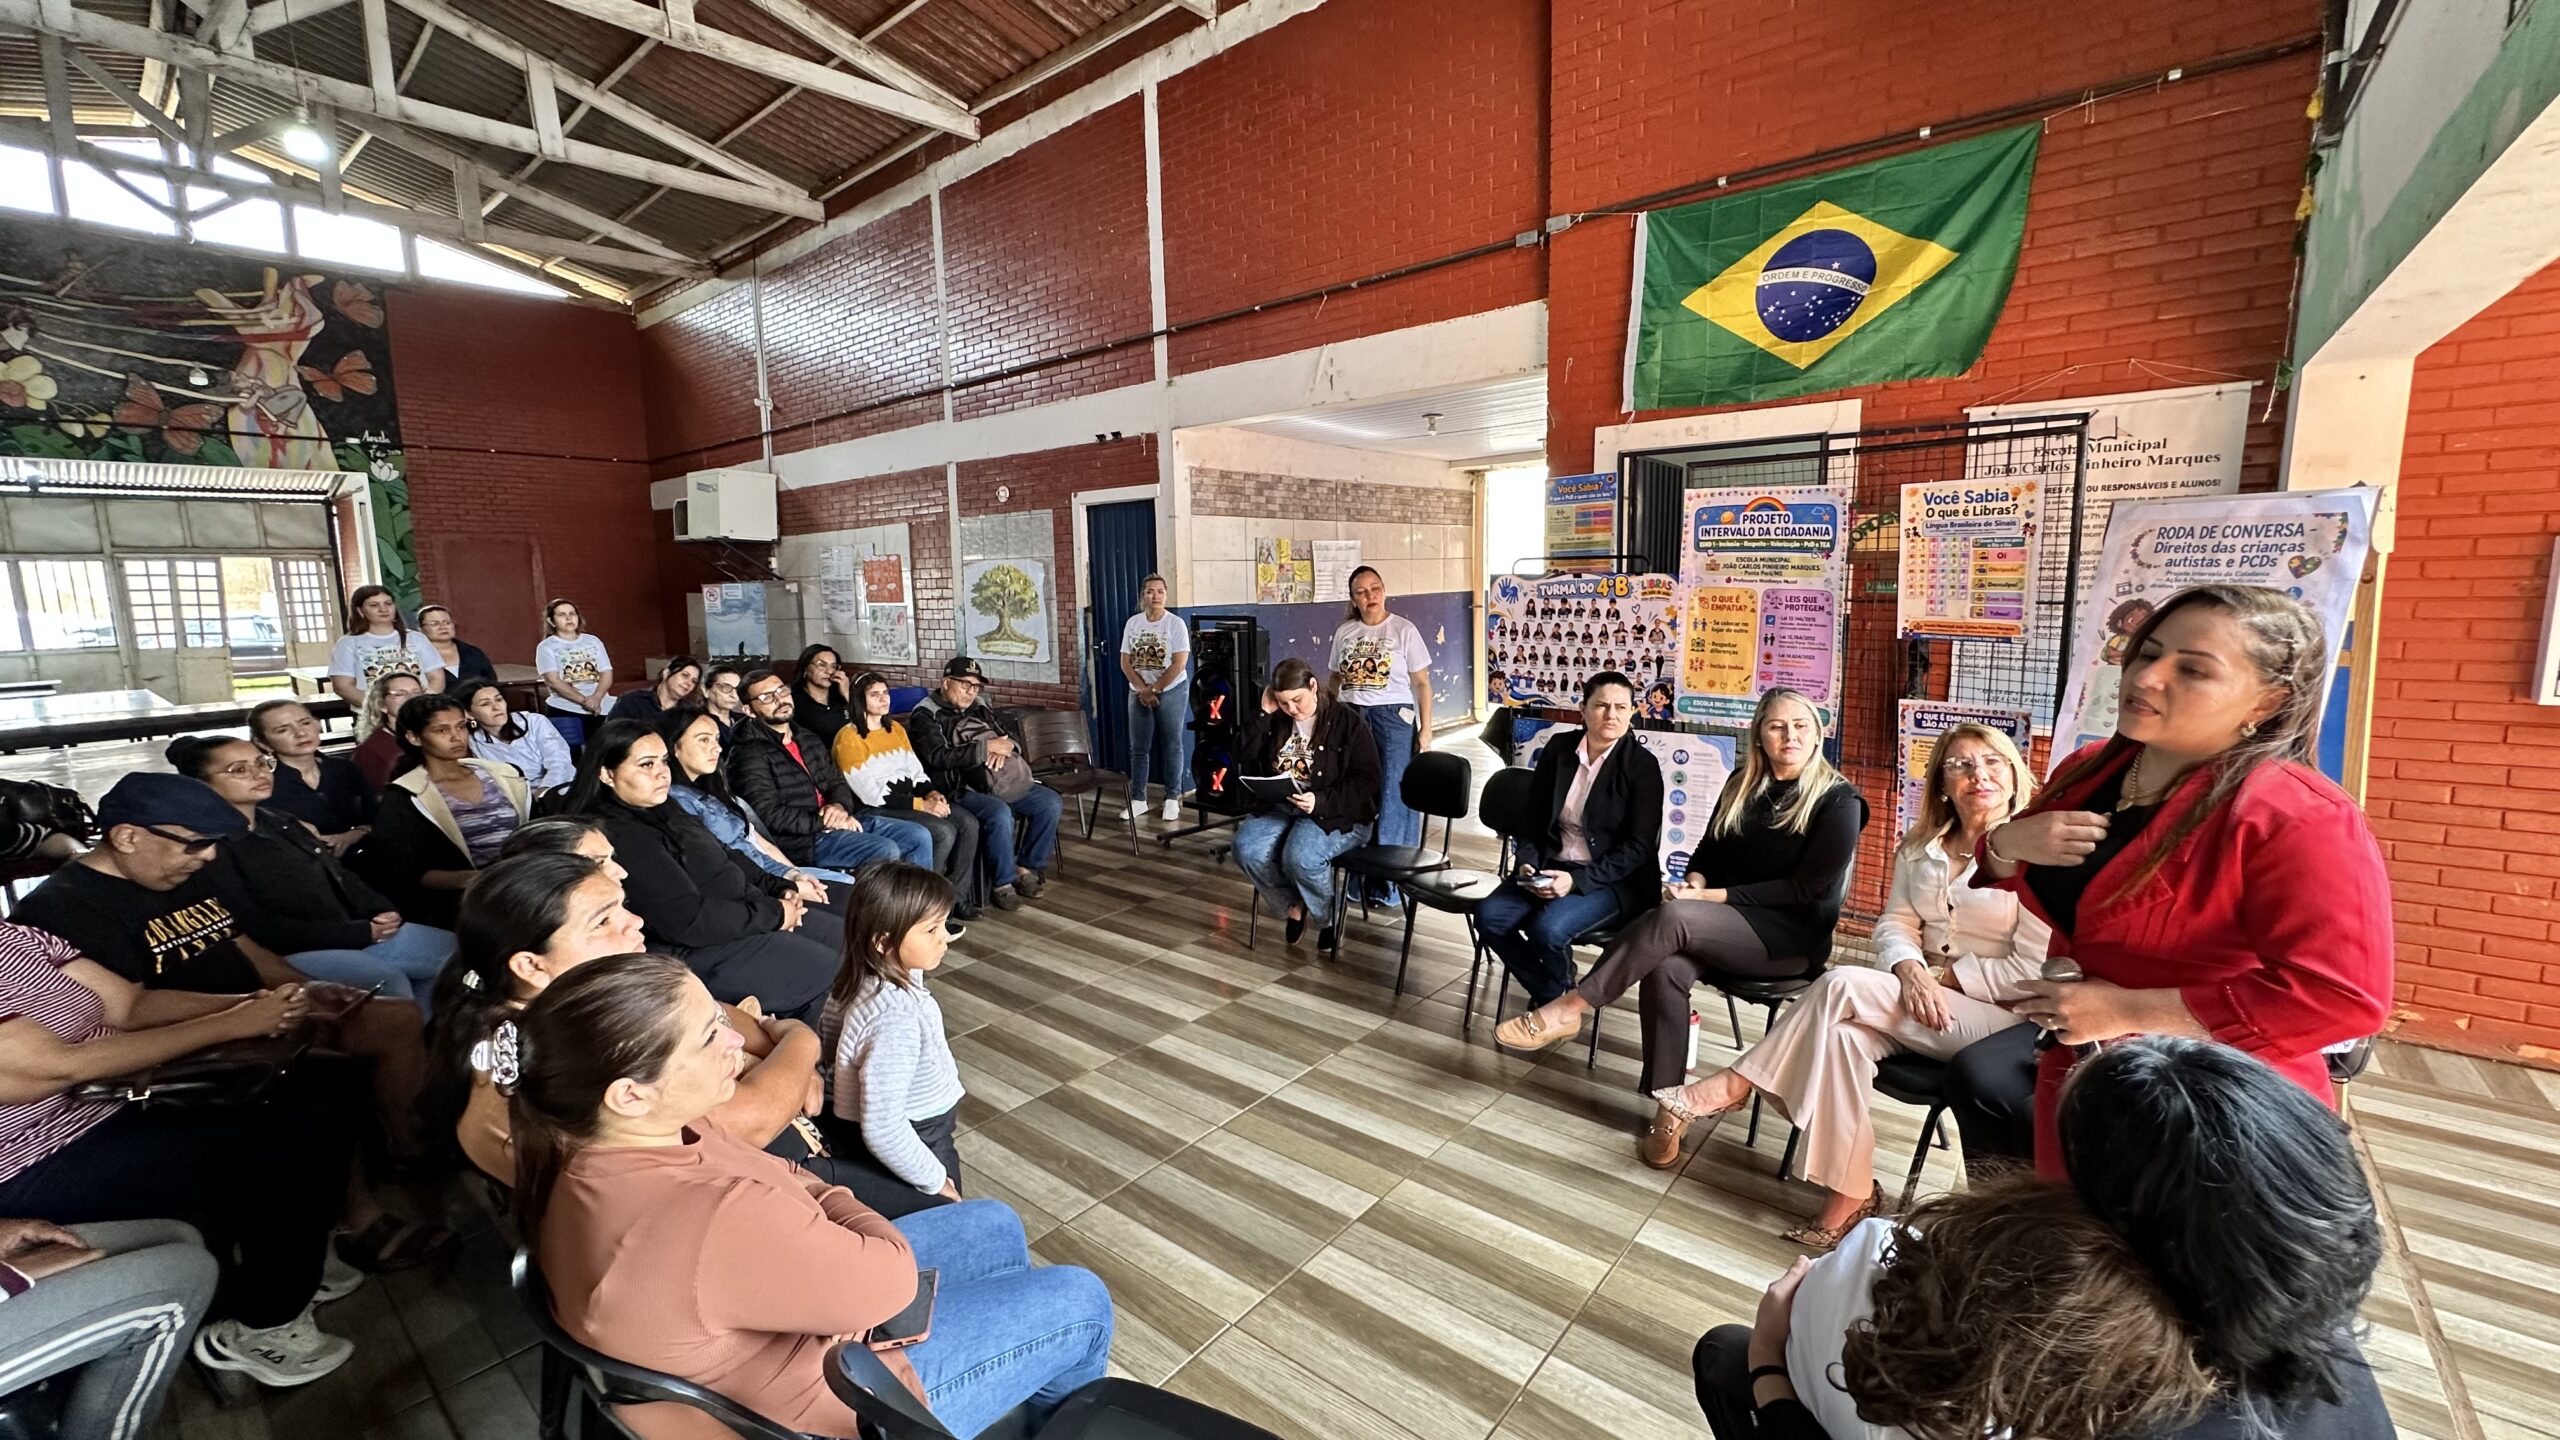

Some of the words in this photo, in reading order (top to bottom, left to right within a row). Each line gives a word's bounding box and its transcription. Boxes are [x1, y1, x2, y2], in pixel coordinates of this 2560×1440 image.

[1762, 270, 1800, 282] ORDEM
[1801, 270, 1809, 279] E
[1810, 270, 1868, 293] PROGRESSO
[2087, 437, 2167, 455] Municipal
[1984, 464, 2017, 477] João
[2022, 461, 2071, 475] Carlos
[2085, 457, 2141, 470] inheiro
[2147, 452, 2222, 468] Marques
[1558, 485, 1577, 494] Você
[1579, 481, 1604, 493] Sabia?
[2086, 485, 2099, 493] OU
[2101, 480, 2169, 492] RESPONSÁVEIS
[2179, 479, 2222, 488] ALUNOS!
[1923, 490, 1960, 506] Você
[1964, 488, 2009, 505] Sabia
[1926, 508, 1934, 518] O
[1938, 507, 1959, 519] que
[1963, 506, 1969, 517] é
[1972, 504, 2018, 517] Libras?
[1742, 513, 1791, 525] PROJETO
[1925, 521, 1949, 530] Língua
[1950, 521, 1982, 529] Brasileira
[1995, 519, 2017, 527] Sinais
[1701, 527, 1755, 538] INTERVALO
[1758, 527, 1772, 537] DA
[1774, 526, 1831, 537] CIDADANIA
[2156, 526, 2196, 540] RODA
[2198, 526, 2218, 539] DE
[2221, 523, 2305, 539] CONVERSA
[2154, 541, 2207, 554] Direitos
[2211, 541, 2236, 553] das
[2240, 541, 2305, 555] crianças
[1997, 552, 2007, 560] Oi
[2165, 555, 2222, 568] autistas
[2226, 558, 2235, 568] e
[2239, 554, 2278, 568] PCDs
[1539, 583, 1577, 597] TURMA
[1579, 582, 1594, 594] DO
[1641, 578, 1673, 590] LIBRAS
[1735, 595, 1740, 603] É
[1804, 596, 1818, 604] QUE
[1711, 604, 1748, 612] EMPATIA?
[1785, 604, 1825, 612] PROTEGEM
[1916, 712, 1922, 720] O
[1923, 713, 1939, 721] QUE
[1939, 712, 1945, 721] É
[1946, 714, 1983, 724] EMPATIA?
[1990, 718, 2015, 728] QUAIS
[1921, 719, 1936, 728] SÃO
[145, 918, 176, 947] LOS
[250, 1348, 287, 1364] FILA
